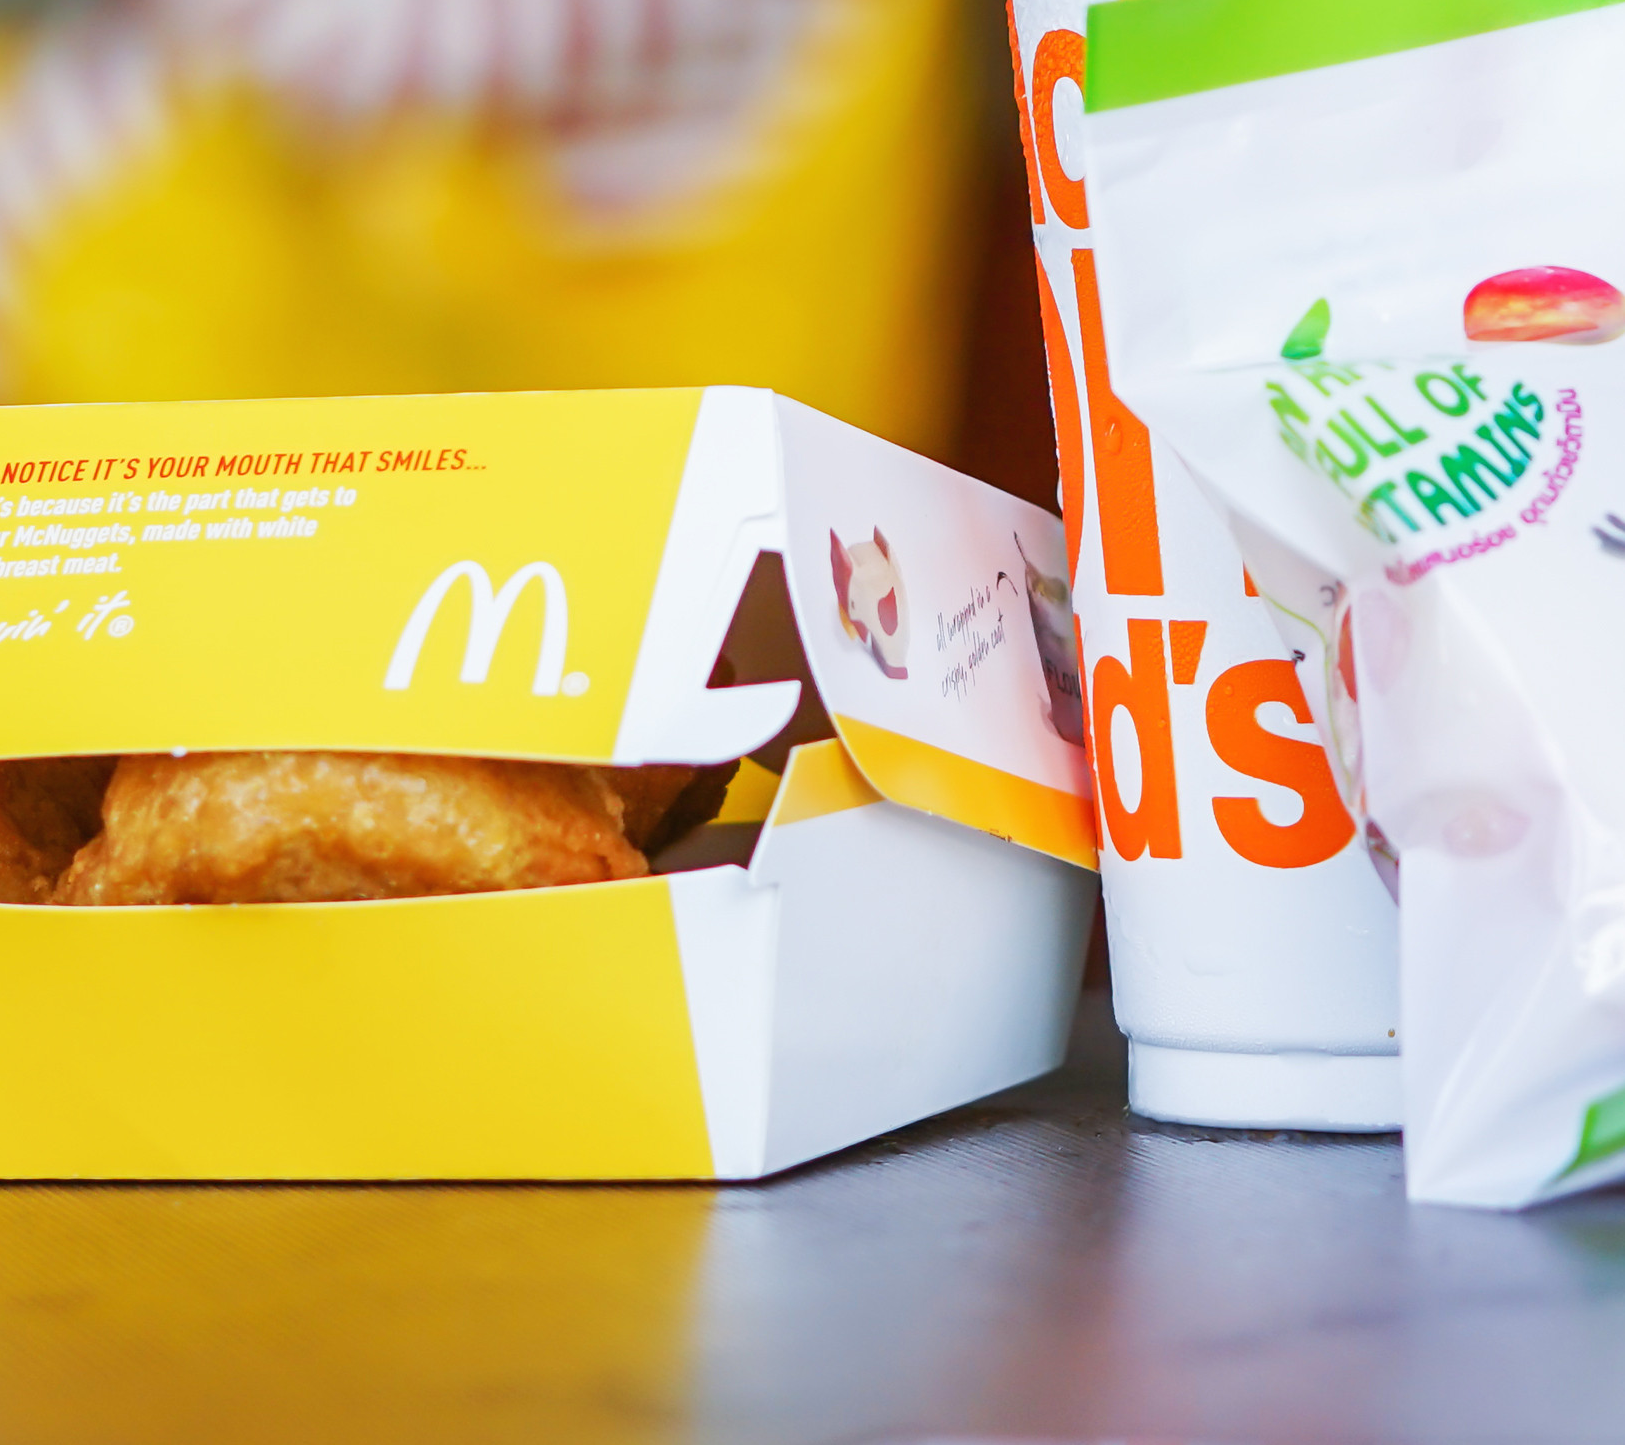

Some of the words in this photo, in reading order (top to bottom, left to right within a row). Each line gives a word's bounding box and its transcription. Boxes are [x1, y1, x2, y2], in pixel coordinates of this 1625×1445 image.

[0, 460, 89, 485] NOTICE
[92, 458, 140, 481] IT'S
[147, 456, 210, 479] YOUR
[215, 453, 303, 477] MOUTH
[310, 451, 373, 474] THAT
[376, 448, 487, 472] SMILES...
[16, 495, 104, 517] because
[107, 491, 143, 513] it's
[146, 490, 181, 512] the
[184, 489, 231, 515] part
[234, 488, 279, 509] that
[279, 487, 330, 512] gets
[334, 486, 357, 506] to
[12, 523, 136, 549] McNuggets,
[141, 519, 201, 542] made
[205, 517, 253, 540] with
[257, 515, 318, 538] white
[62, 552, 122, 575] meat.
[1073, 613, 1357, 869] d's
